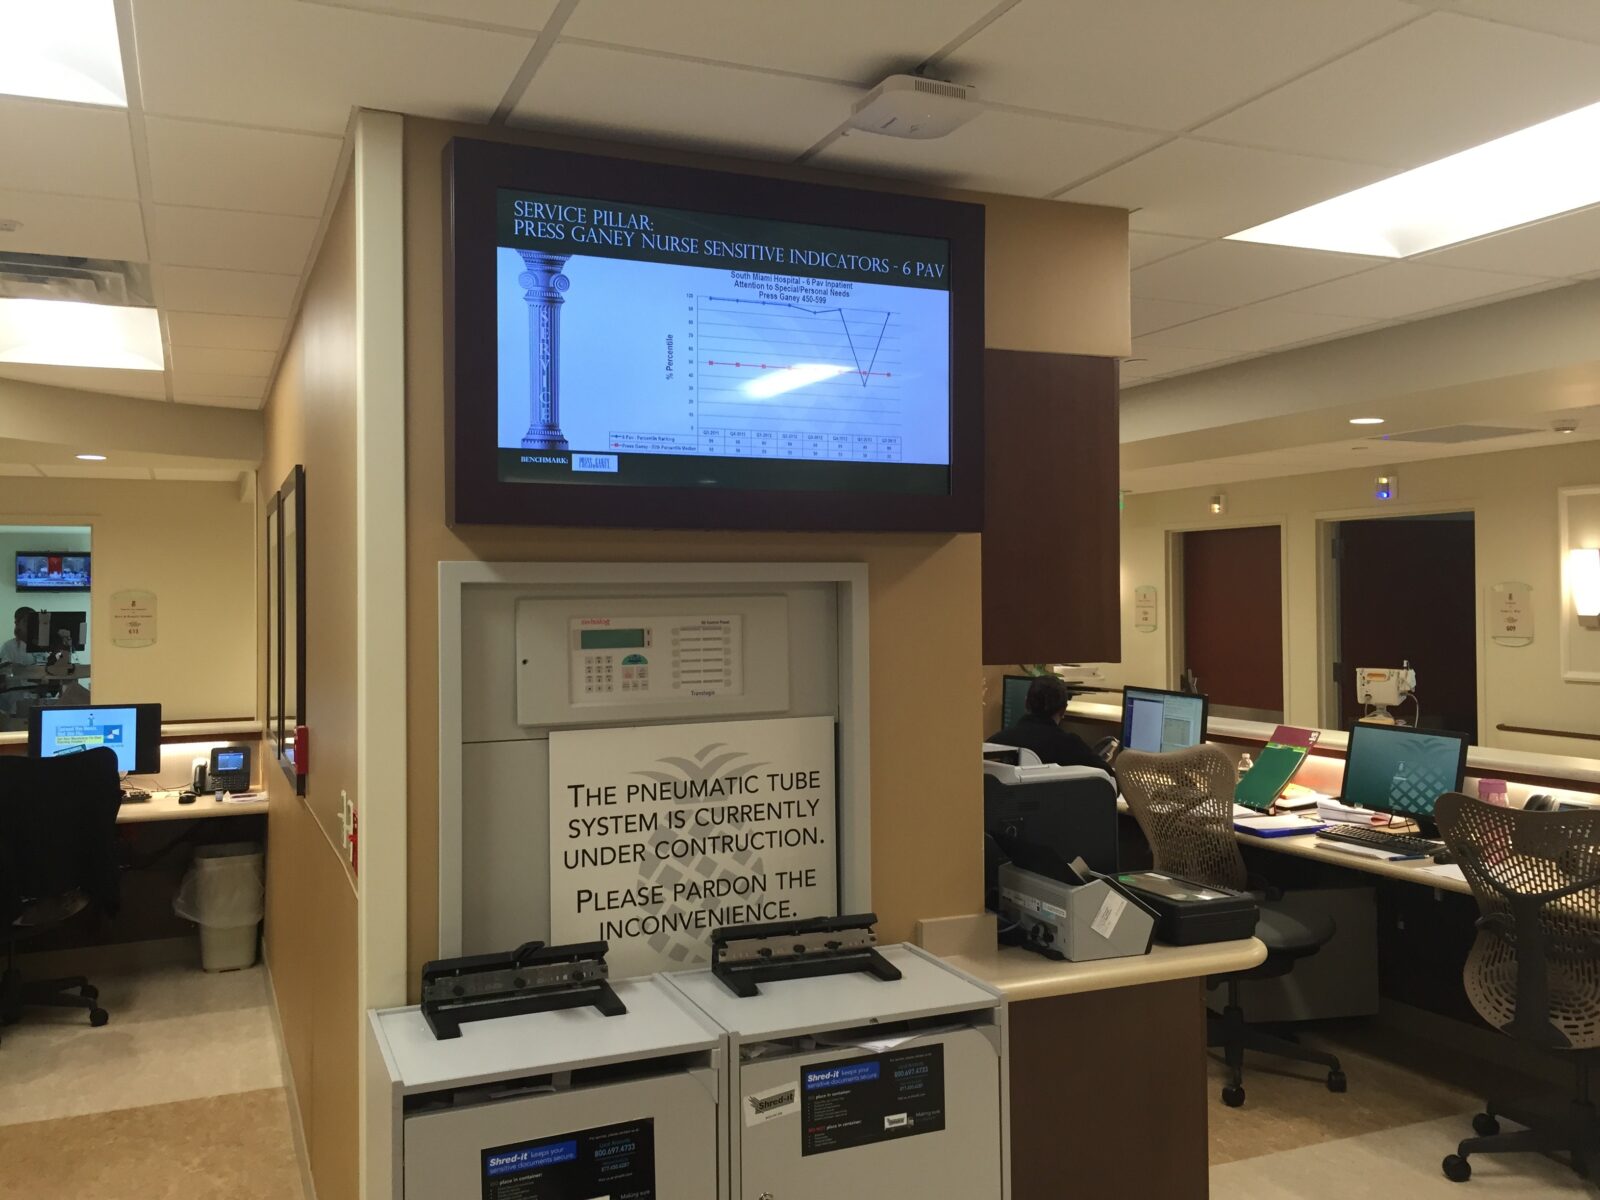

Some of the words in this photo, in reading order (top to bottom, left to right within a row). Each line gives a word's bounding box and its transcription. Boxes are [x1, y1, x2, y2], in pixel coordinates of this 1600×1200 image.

[514, 200, 587, 224] SERVICE
[593, 209, 655, 231] PILLAR:
[514, 219, 565, 240] PRESS
[571, 226, 635, 247] GANEY
[641, 233, 699, 254] NURSE
[704, 239, 785, 263] SENSITIVE
[790, 249, 889, 273] INDICATORS
[902, 261, 911, 275] 6
[916, 262, 945, 279] PAV
[731, 270, 751, 280] South
[752, 272, 773, 281] Miami
[774, 274, 801, 285] Hospital
[825, 280, 853, 290] Inpatient
[734, 280, 765, 290] Attention
[830, 289, 850, 298] Needs
[759, 291, 778, 300] Press
[780, 293, 800, 303] Ganey
[665, 334, 674, 371] Percentile
[520, 456, 568, 464] BENCHMARK:
[626, 775, 760, 803] PNEUMATIC
[766, 770, 821, 792] TUBE
[568, 813, 658, 839] SYSTEM
[668, 810, 686, 829] IS
[694, 799, 820, 827] CURRENTLY
[564, 843, 646, 869] UNDER
[654, 827, 825, 860] CONTRUCTION.
[673, 874, 767, 902] PARDON
[775, 869, 817, 890] THE
[600, 899, 798, 941] INCONVENIENCE.
[807, 1070, 840, 1082] Shred-it
[758, 1093, 793, 1109] Shred-it
[489, 1152, 528, 1167] Shred-it
[530, 1150, 550, 1158] keeps
[551, 1147, 565, 1156] your
[594, 1143, 636, 1158] 800.697.4733
[489, 1164, 517, 1175] sensitive
[518, 1157, 553, 1169] documents
